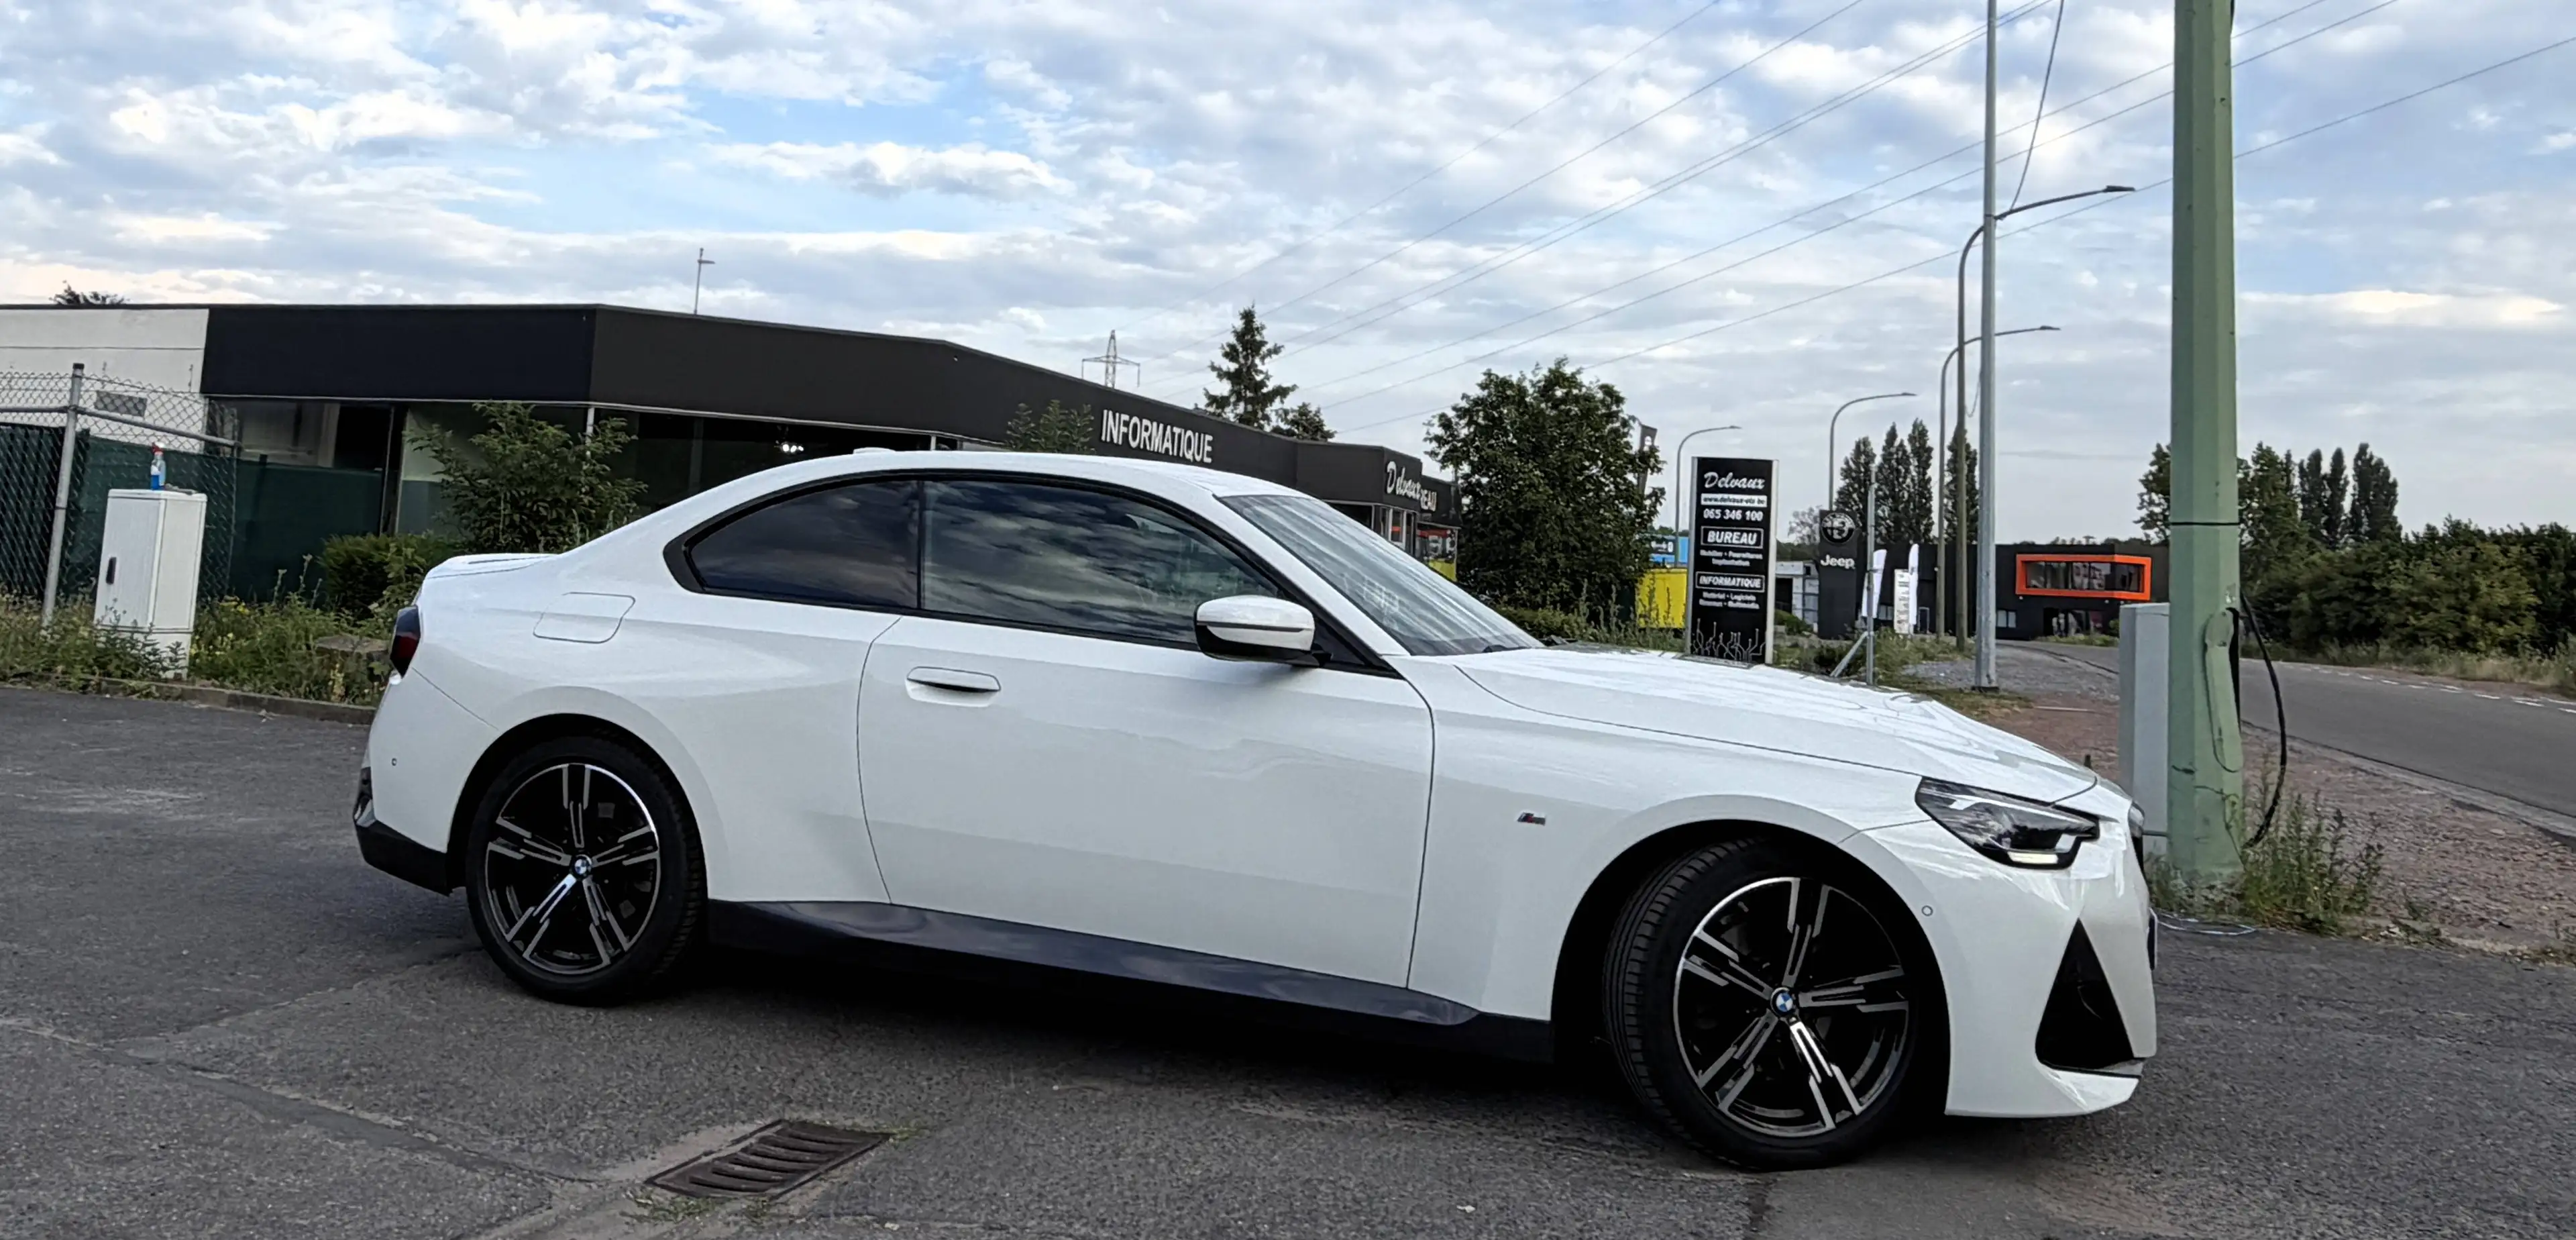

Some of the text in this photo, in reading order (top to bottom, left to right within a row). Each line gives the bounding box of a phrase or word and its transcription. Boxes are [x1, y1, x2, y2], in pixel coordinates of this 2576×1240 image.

[1102, 409, 1214, 463] INFORMATIQUE
[1704, 472, 1766, 489] Delvaux
[1703, 509, 1722, 519] 065
[1746, 511, 1764, 521] 100
[1707, 530, 1757, 545] BUREAU
[1820, 554, 1856, 569] Jeep
[1700, 576, 1762, 588] INFORMATIQUE
